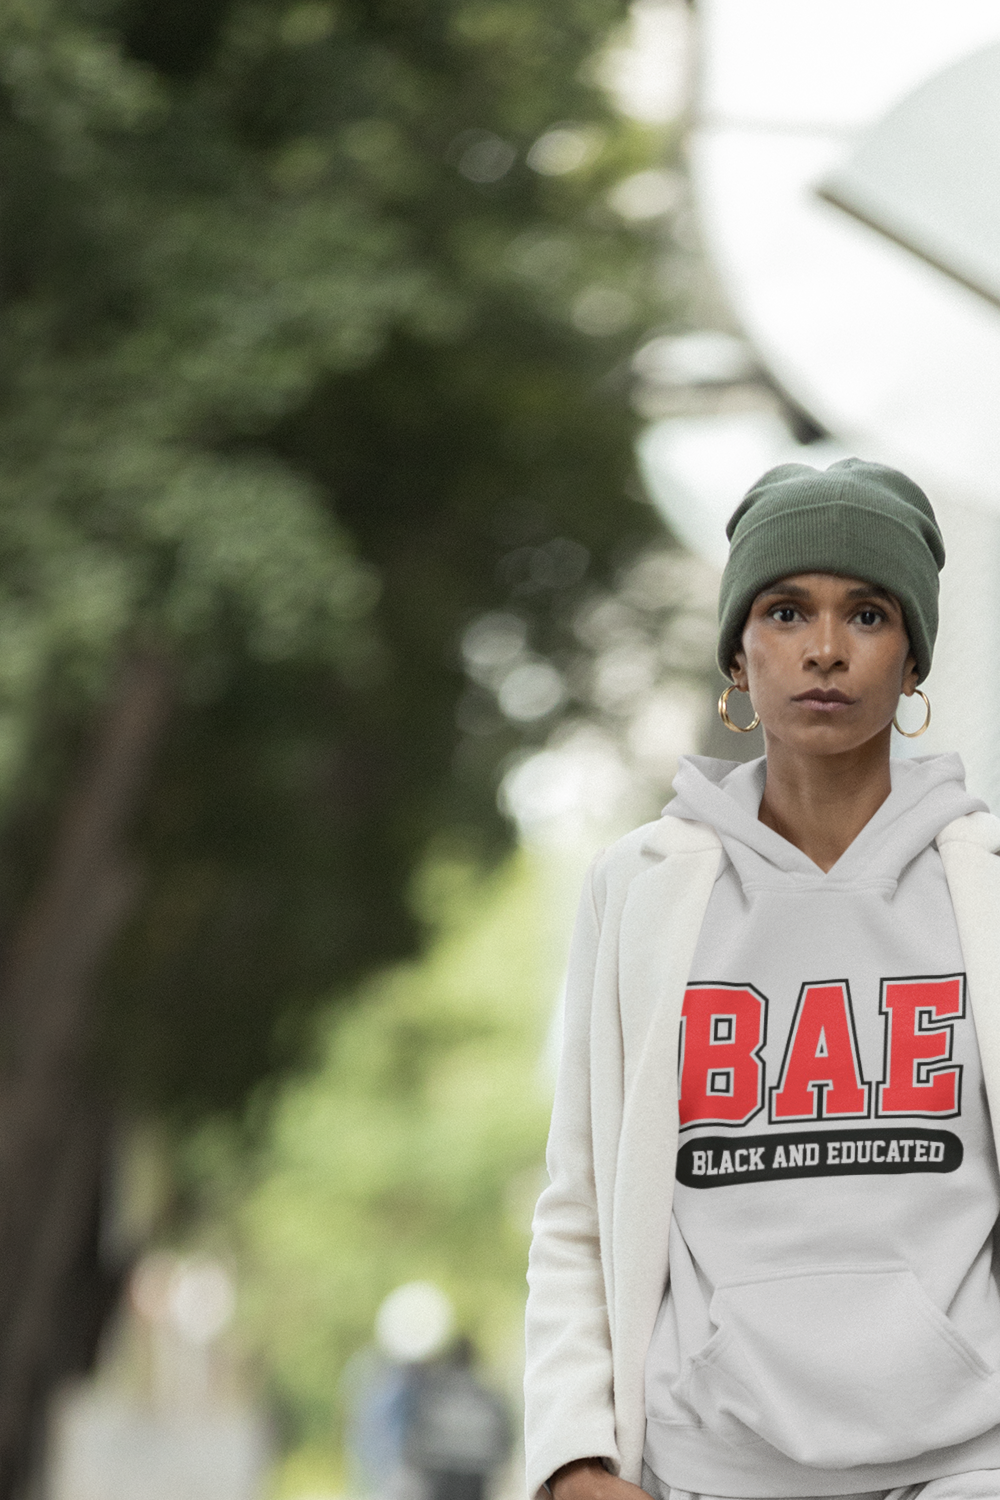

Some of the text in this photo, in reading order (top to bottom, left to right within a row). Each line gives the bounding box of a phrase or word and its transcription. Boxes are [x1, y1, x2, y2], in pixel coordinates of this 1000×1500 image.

[677, 972, 966, 1133] BAE
[692, 1139, 945, 1176] BLACK AND EDUCATED
